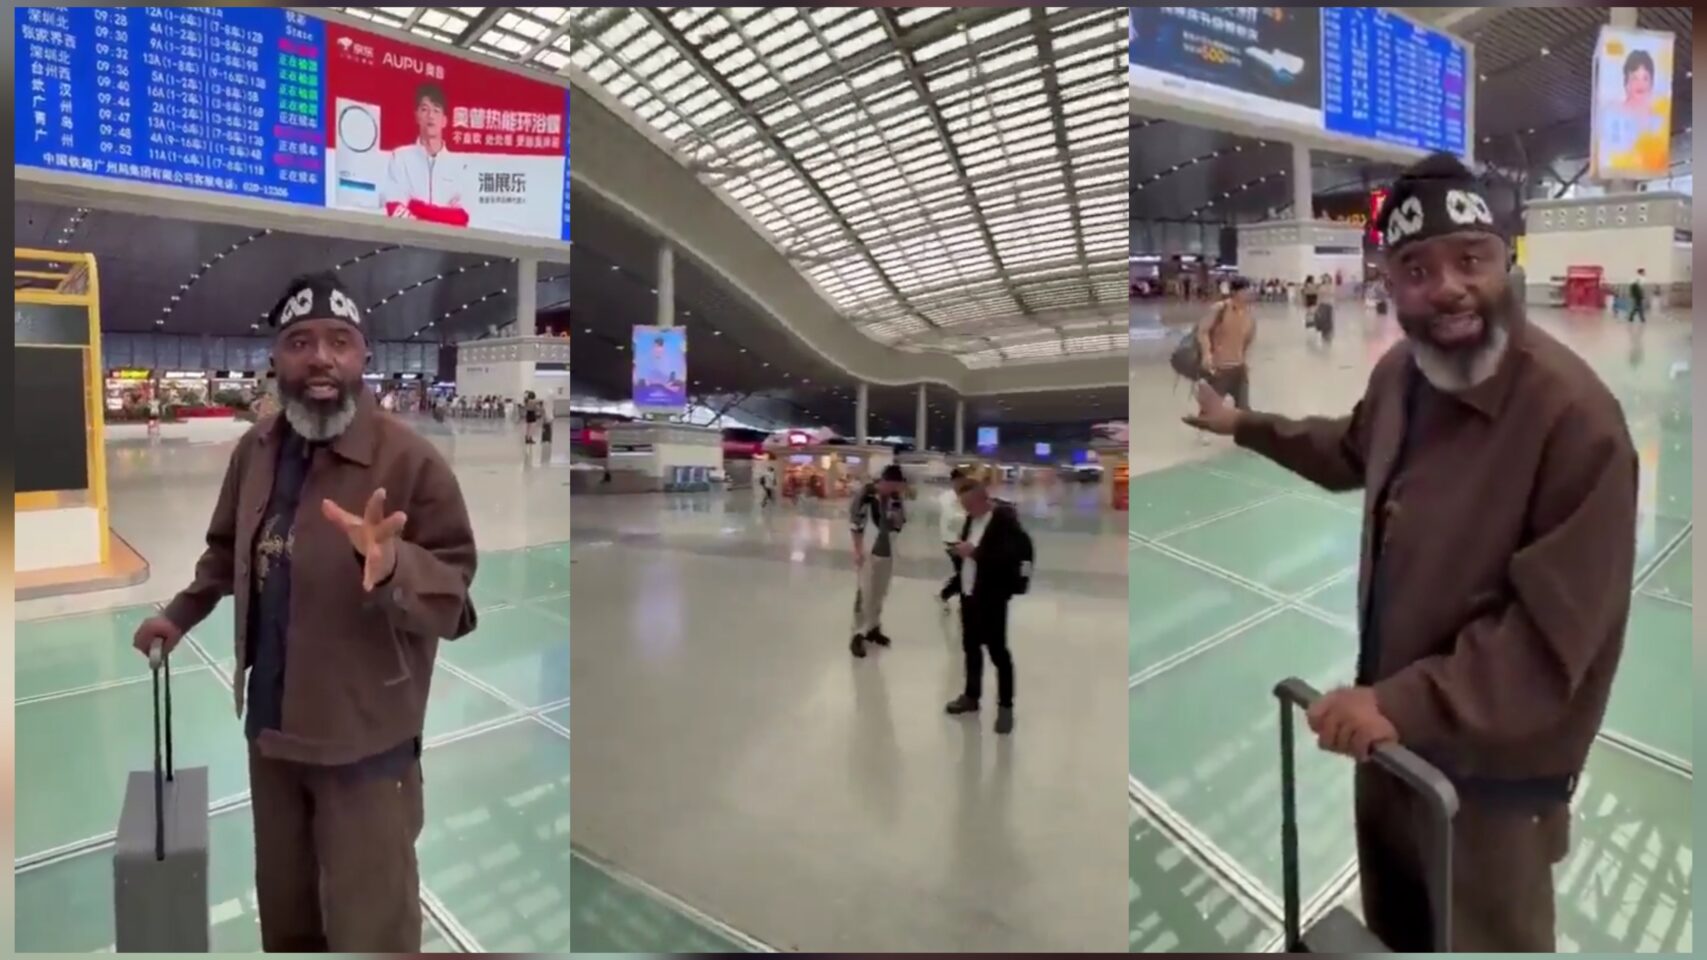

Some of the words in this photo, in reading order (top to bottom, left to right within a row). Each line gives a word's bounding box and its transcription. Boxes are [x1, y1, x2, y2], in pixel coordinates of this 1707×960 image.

[28, 8, 69, 30] 深圳北
[95, 26, 128, 43] 09:30
[95, 9, 128, 27] 09:28
[21, 24, 76, 48] 张家界西
[96, 43, 129, 60] 09:32
[30, 44, 71, 65] 深圳北
[97, 60, 129, 77] 09:36
[382, 52, 424, 74] AUPU
[97, 75, 130, 92] 09:40
[98, 92, 131, 108] 09:44
[99, 108, 131, 123] 09:47
[99, 124, 132, 140] 09:48
[100, 141, 132, 157] 09:52
